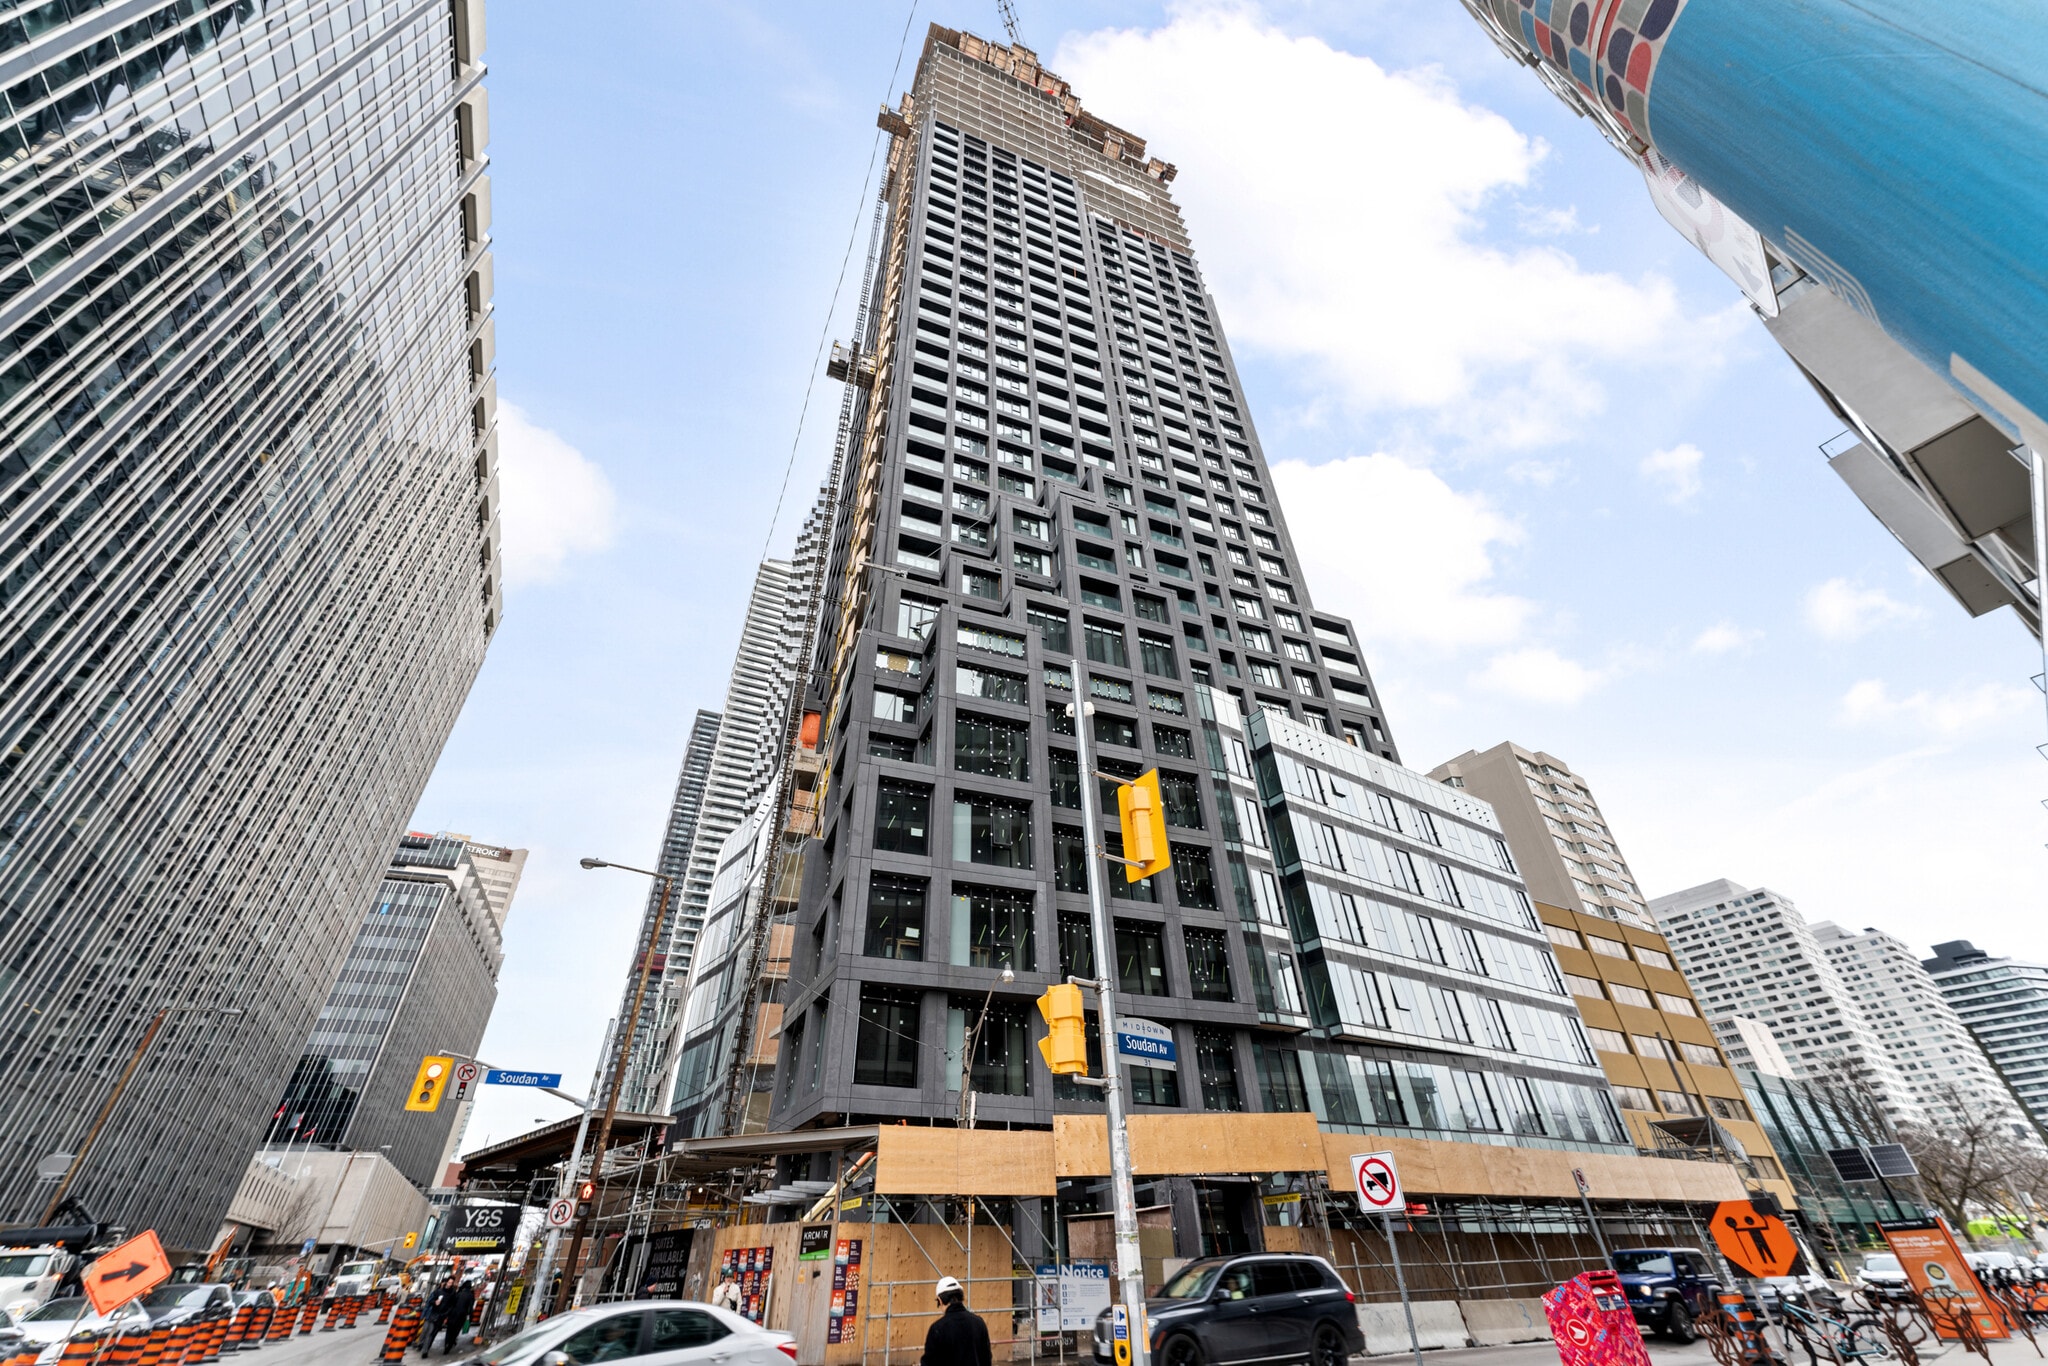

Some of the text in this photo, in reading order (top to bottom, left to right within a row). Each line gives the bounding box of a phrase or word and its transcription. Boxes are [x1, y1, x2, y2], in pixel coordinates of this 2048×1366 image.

[466, 845, 501, 857] STROKE
[1122, 1021, 1164, 1035] MIDTOWN
[1125, 1035, 1168, 1055] Soudan Av
[499, 1072, 538, 1085] Soudan
[465, 1209, 503, 1227] Y&S
[655, 1236, 675, 1249] SUITES
[652, 1250, 684, 1264] AVAILABLE
[660, 1265, 677, 1279] SALE
[1061, 1265, 1104, 1278] Notice
